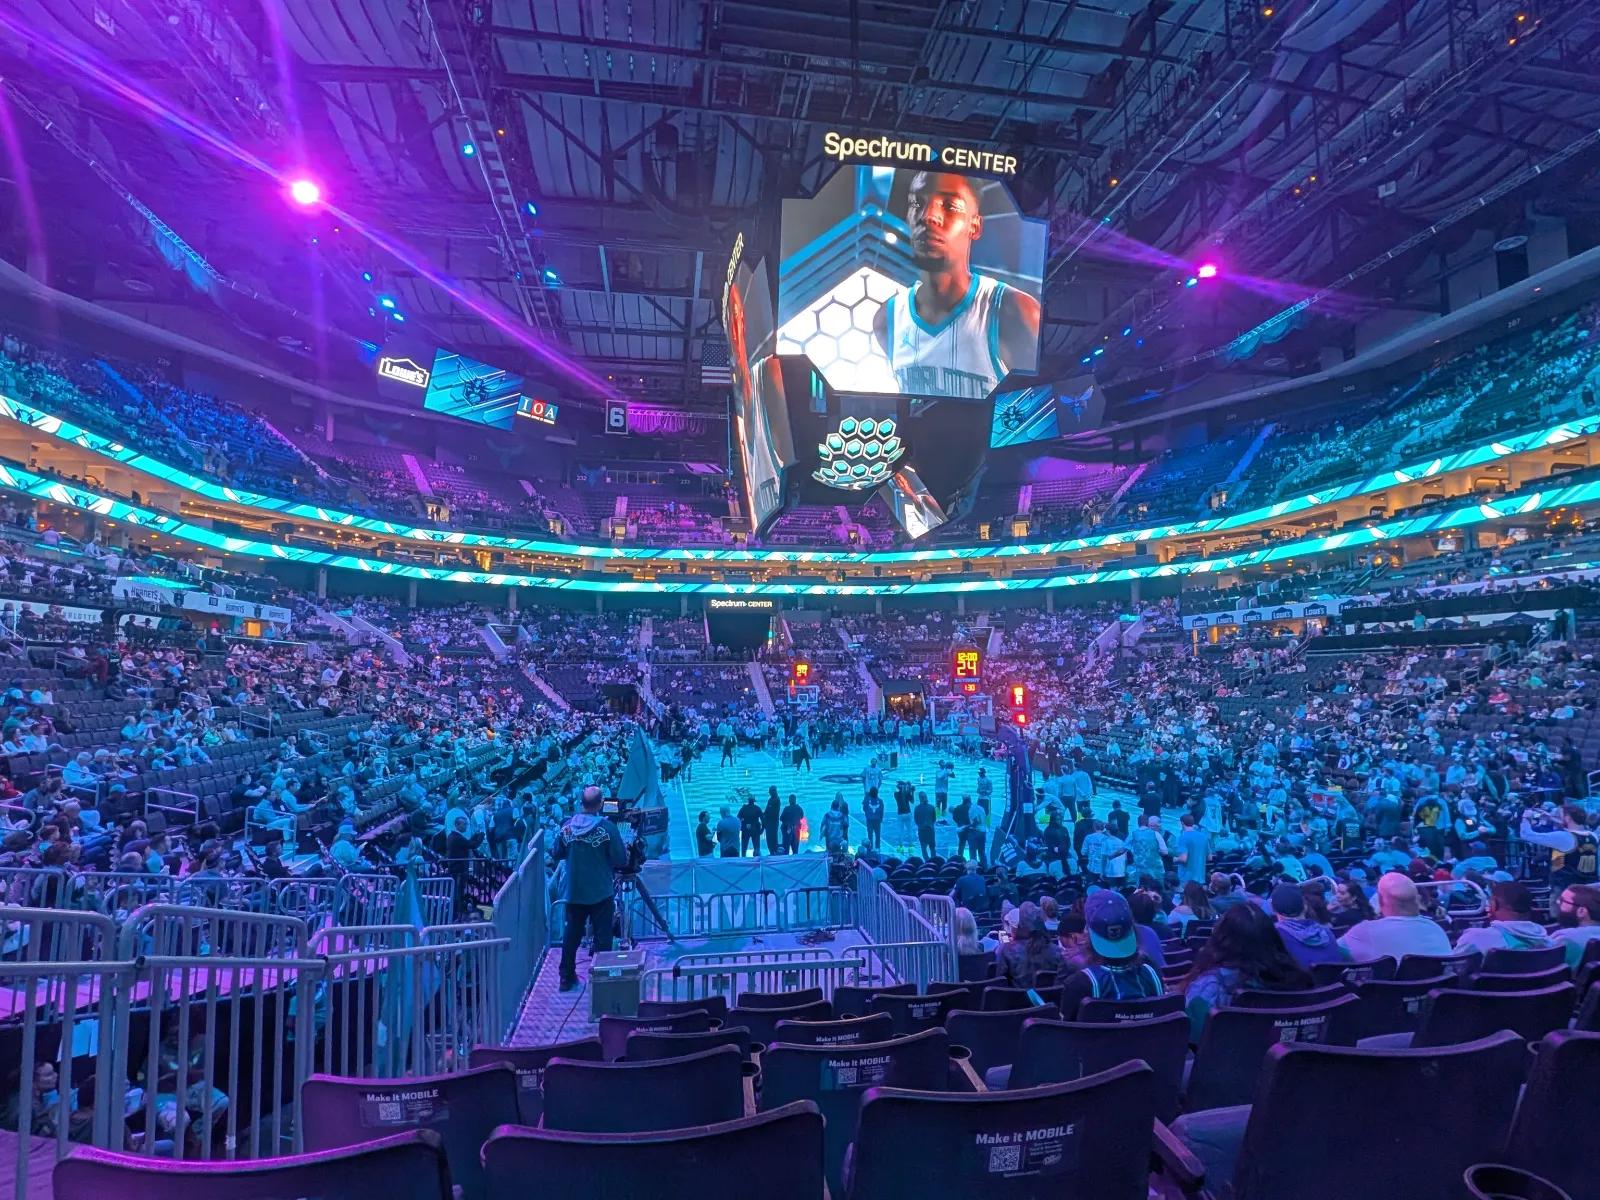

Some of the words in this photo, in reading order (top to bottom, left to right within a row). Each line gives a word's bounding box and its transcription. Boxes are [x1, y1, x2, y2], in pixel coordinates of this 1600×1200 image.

[824, 132, 931, 161] Spectrum
[941, 147, 1017, 175] CENTER
[609, 407, 625, 428] 6
[711, 600, 746, 609] Spectrum
[956, 660, 977, 676] 24
[838, 1032, 860, 1041] MOBILE
[859, 1055, 891, 1067] MOBILE
[366, 1093, 391, 1102] Make
[402, 1089, 439, 1101] MOBILE
[976, 1132, 1010, 1144] Make
[1013, 1132, 1023, 1143] it
[1026, 1124, 1075, 1141] MOBILE
